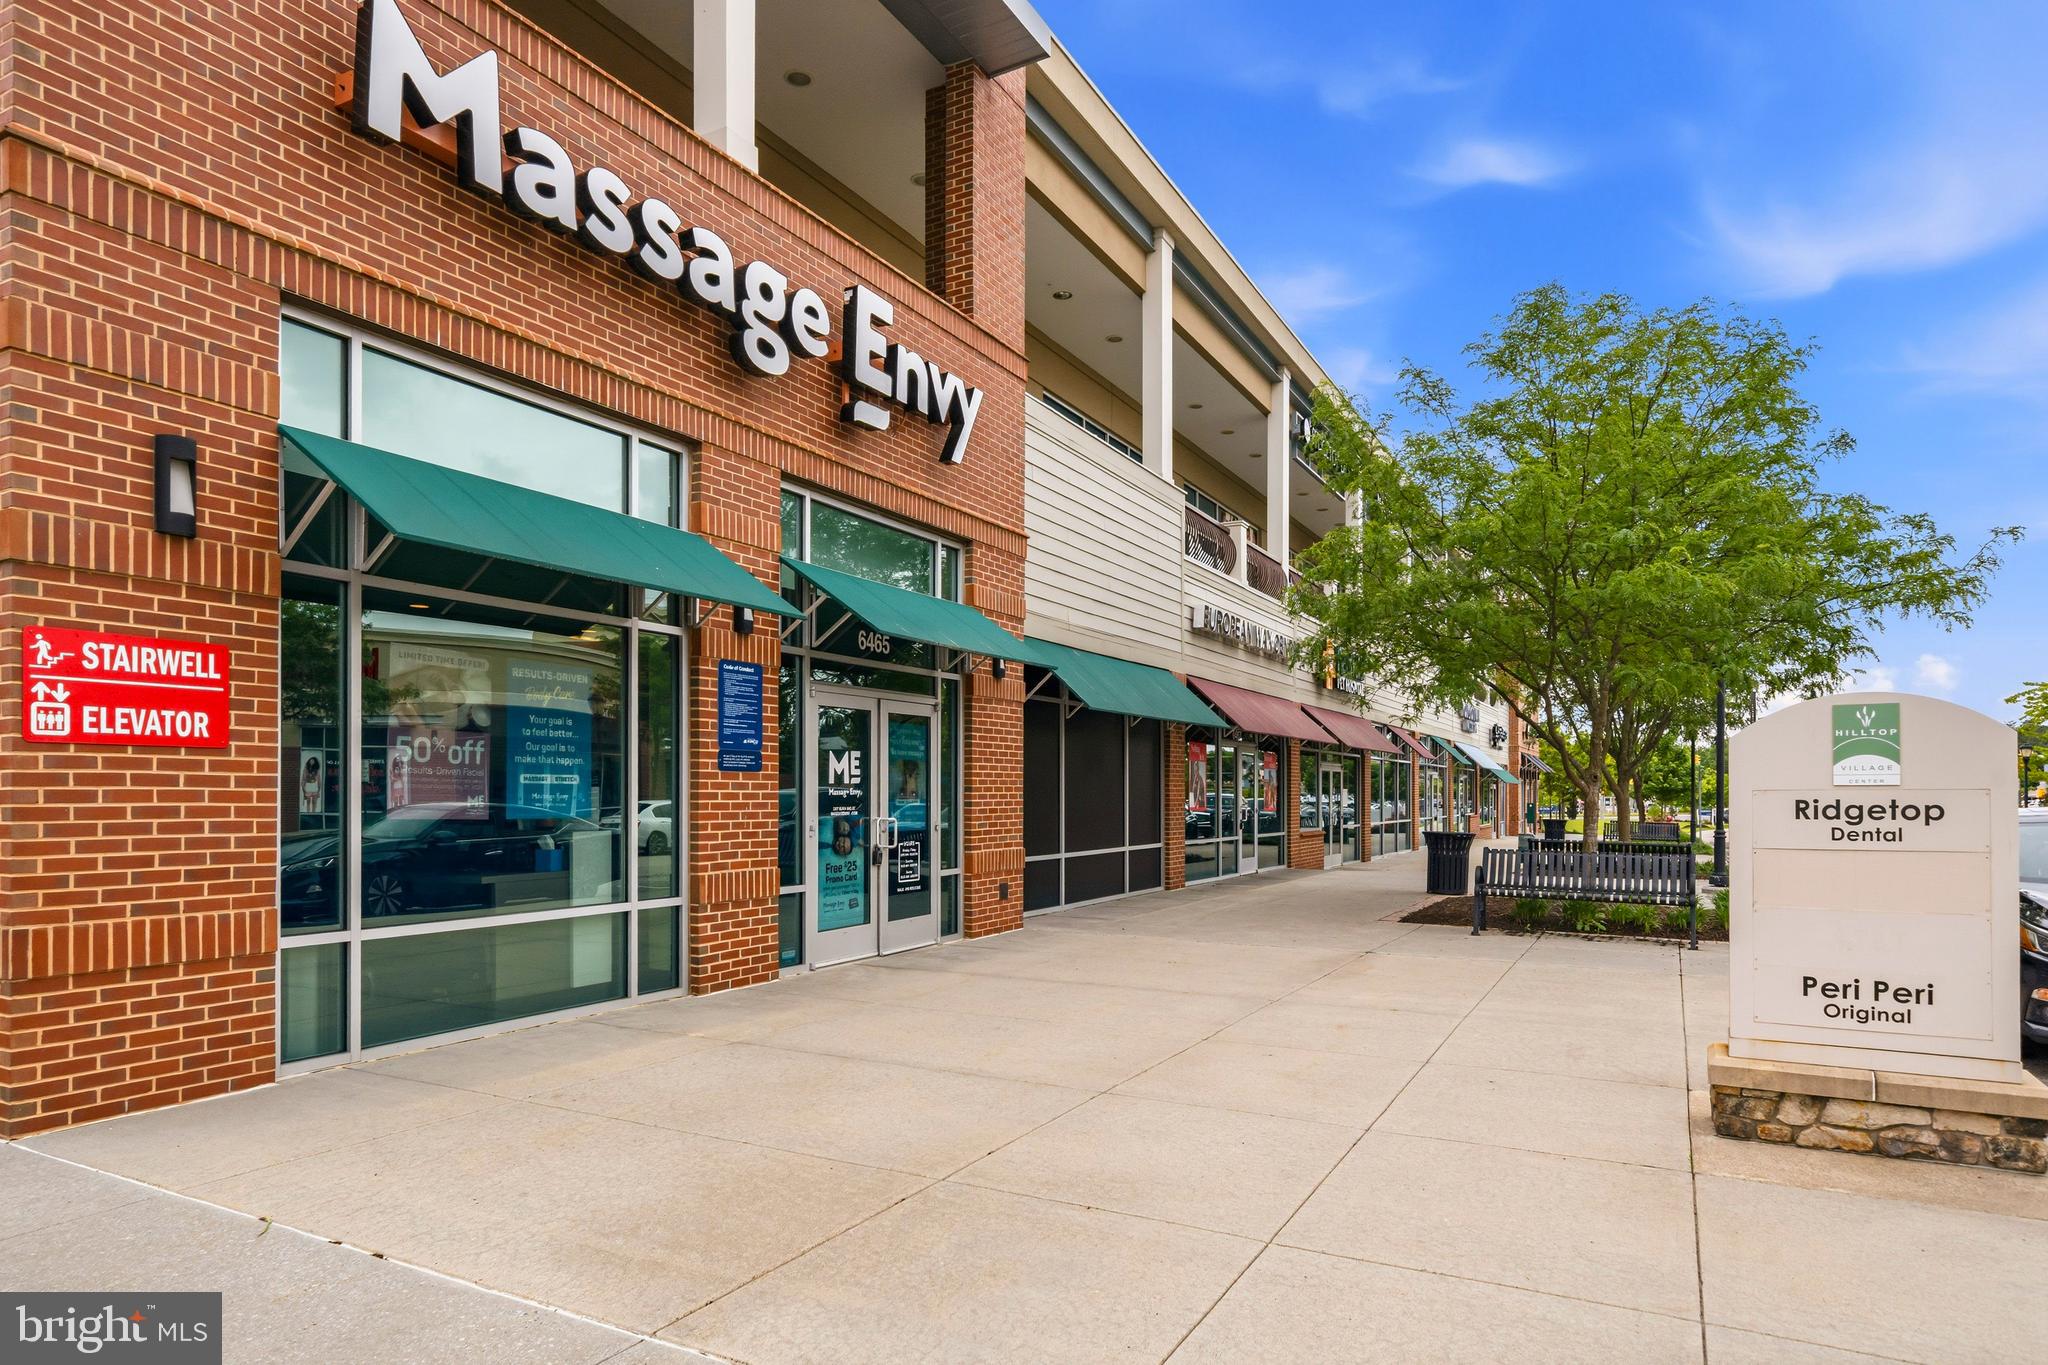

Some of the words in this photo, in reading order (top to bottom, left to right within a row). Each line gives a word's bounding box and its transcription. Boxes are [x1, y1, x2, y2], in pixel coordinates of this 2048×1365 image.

[354, 0, 831, 378] Massage
[844, 285, 984, 464] Envy
[1193, 603, 1251, 647] EUROPEAN
[858, 630, 890, 654] 6465
[81, 641, 221, 679] STAIRWELL
[511, 667, 589, 684] RESULTS-DRIVEN
[82, 705, 210, 738] ELEVATOR
[529, 714, 547, 725] Your
[548, 717, 565, 727] goal
[566, 717, 573, 726] is
[522, 728, 531, 736] to
[532, 728, 548, 737] feel
[1835, 728, 1898, 737] HILLTOP
[396, 735, 446, 763] 50%
[447, 740, 486, 765] off
[525, 741, 540, 751] Our
[541, 743, 558, 753] goal
[567, 745, 576, 753] to
[514, 754, 537, 764] make
[538, 755, 555, 764] that
[1841, 764, 1893, 772] VILLAGE
[1795, 799, 1945, 826] Ridgetop
[1831, 827, 1903, 842] Dental
[825, 863, 843, 874] Free
[844, 873, 858, 882] Card
[1802, 976, 1860, 1000] Peri
[1874, 980, 1934, 1006] Peri
[1823, 1003, 1912, 1024] Original
